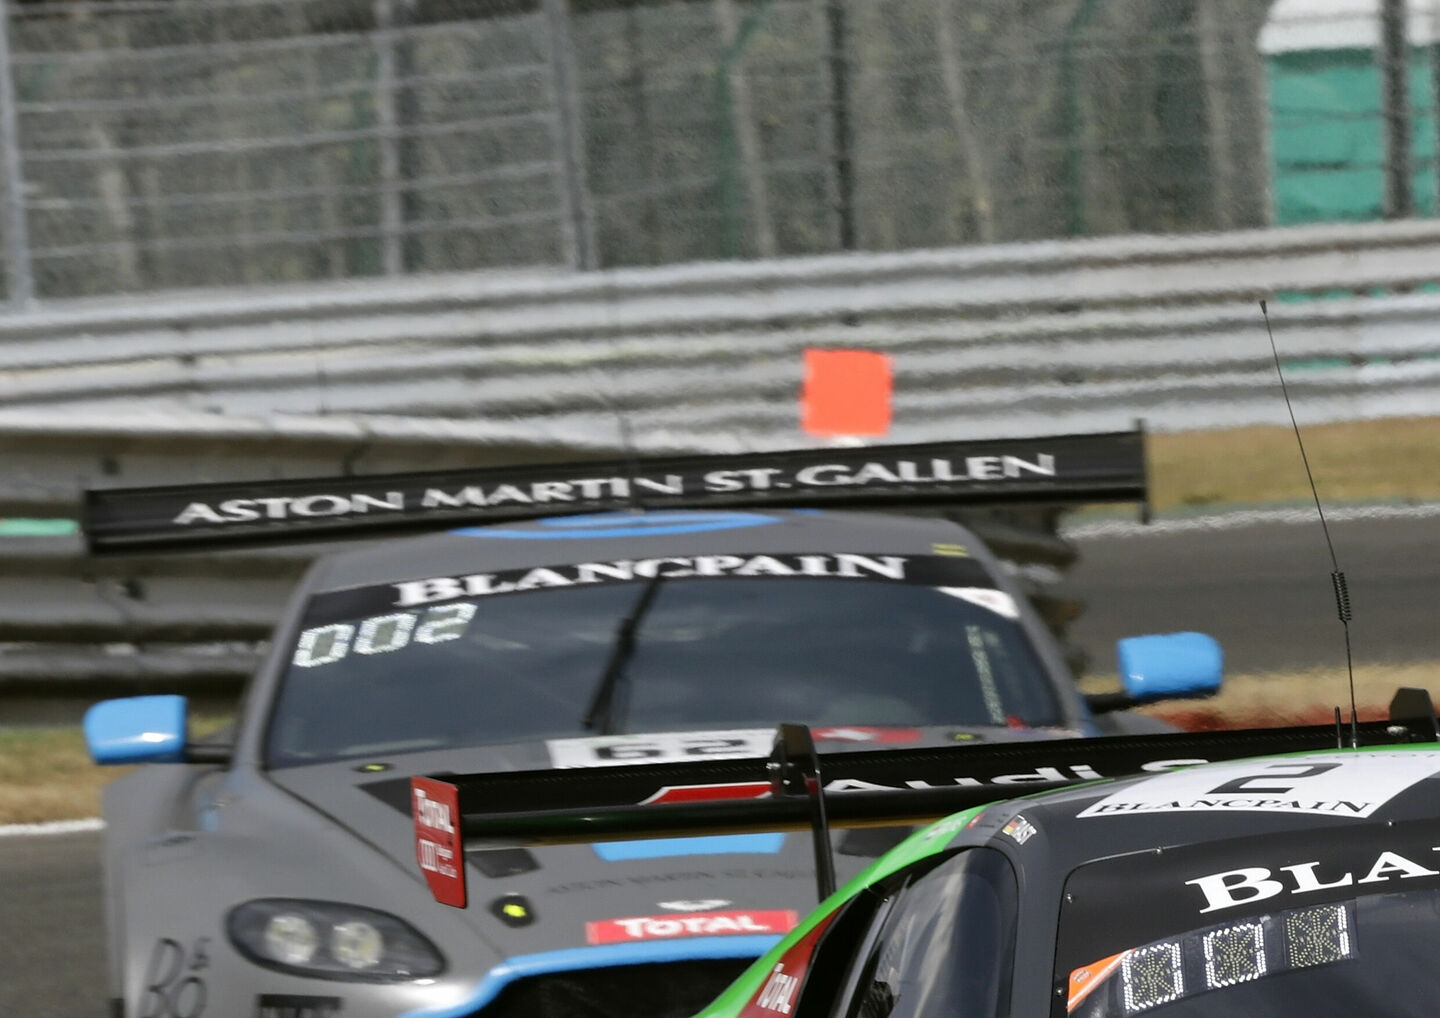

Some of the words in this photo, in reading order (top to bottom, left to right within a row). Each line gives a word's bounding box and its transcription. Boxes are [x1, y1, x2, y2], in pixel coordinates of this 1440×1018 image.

[173, 492, 406, 526] ASTON
[420, 474, 685, 508] MARTIN
[703, 452, 1056, 494] ST.GALLEN
[395, 553, 906, 608] BLANCPAIN
[293, 602, 479, 668] 002
[1205, 762, 1344, 796] 2
[1094, 799, 1375, 814] BLANCPAIN
[614, 914, 771, 938] TOTAL
